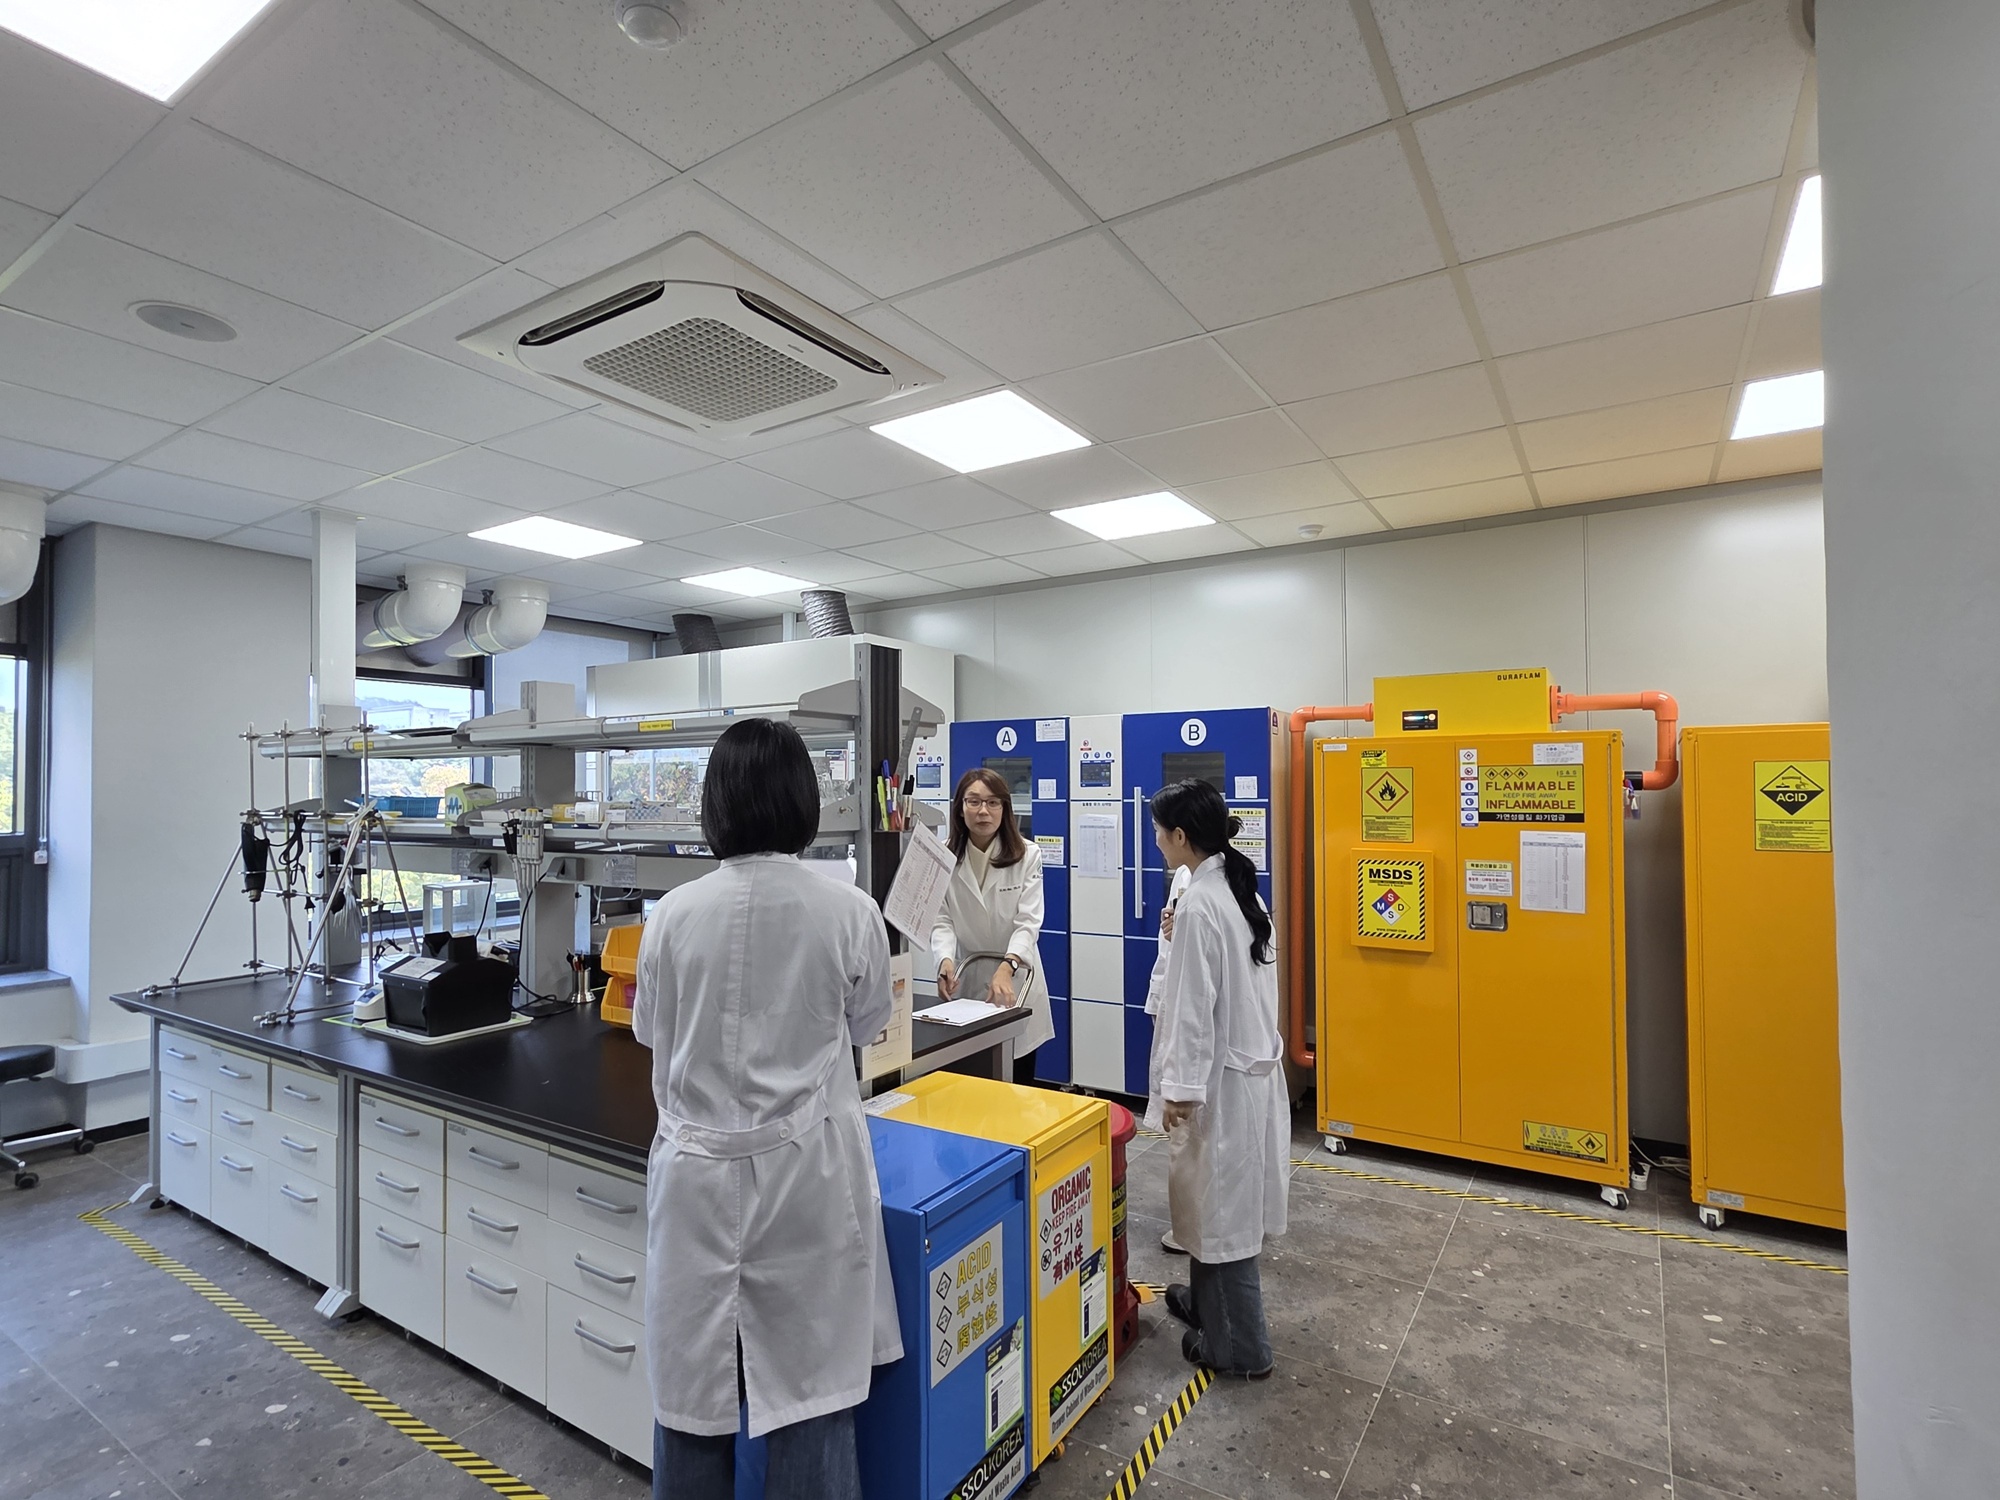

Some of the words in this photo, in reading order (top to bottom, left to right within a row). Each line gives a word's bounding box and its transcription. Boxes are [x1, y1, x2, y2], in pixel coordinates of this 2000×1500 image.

[1497, 672, 1541, 681] DURAFLAM
[1001, 730, 1012, 746] A
[1188, 724, 1200, 741] B
[1485, 781, 1576, 791] FLAMMABLE
[1485, 800, 1576, 809] INFLAMMABLE
[1776, 793, 1808, 802] ACID
[1368, 868, 1413, 880] MSDS
[1387, 893, 1395, 902] S
[1376, 902, 1385, 911] M
[1397, 903, 1405, 911] D
[1388, 911, 1394, 919] S
[1051, 1166, 1091, 1215] ORGANIC
[1051, 1209, 1065, 1231] KEEP
[1065, 1201, 1077, 1221] FIRE
[1077, 1189, 1091, 1214] AWAY
[1053, 1215, 1083, 1256] 유기성
[956, 1241, 992, 1289] ACID
[1053, 1242, 1083, 1285] 有机性
[957, 1268, 998, 1318] 부식성
[1062, 1337, 1107, 1398] SSOLKOREA
[961, 1427, 1022, 1500] SSOLKOREA
[994, 1473, 1009, 1497] Waste
[1010, 1457, 1021, 1480] Acid
